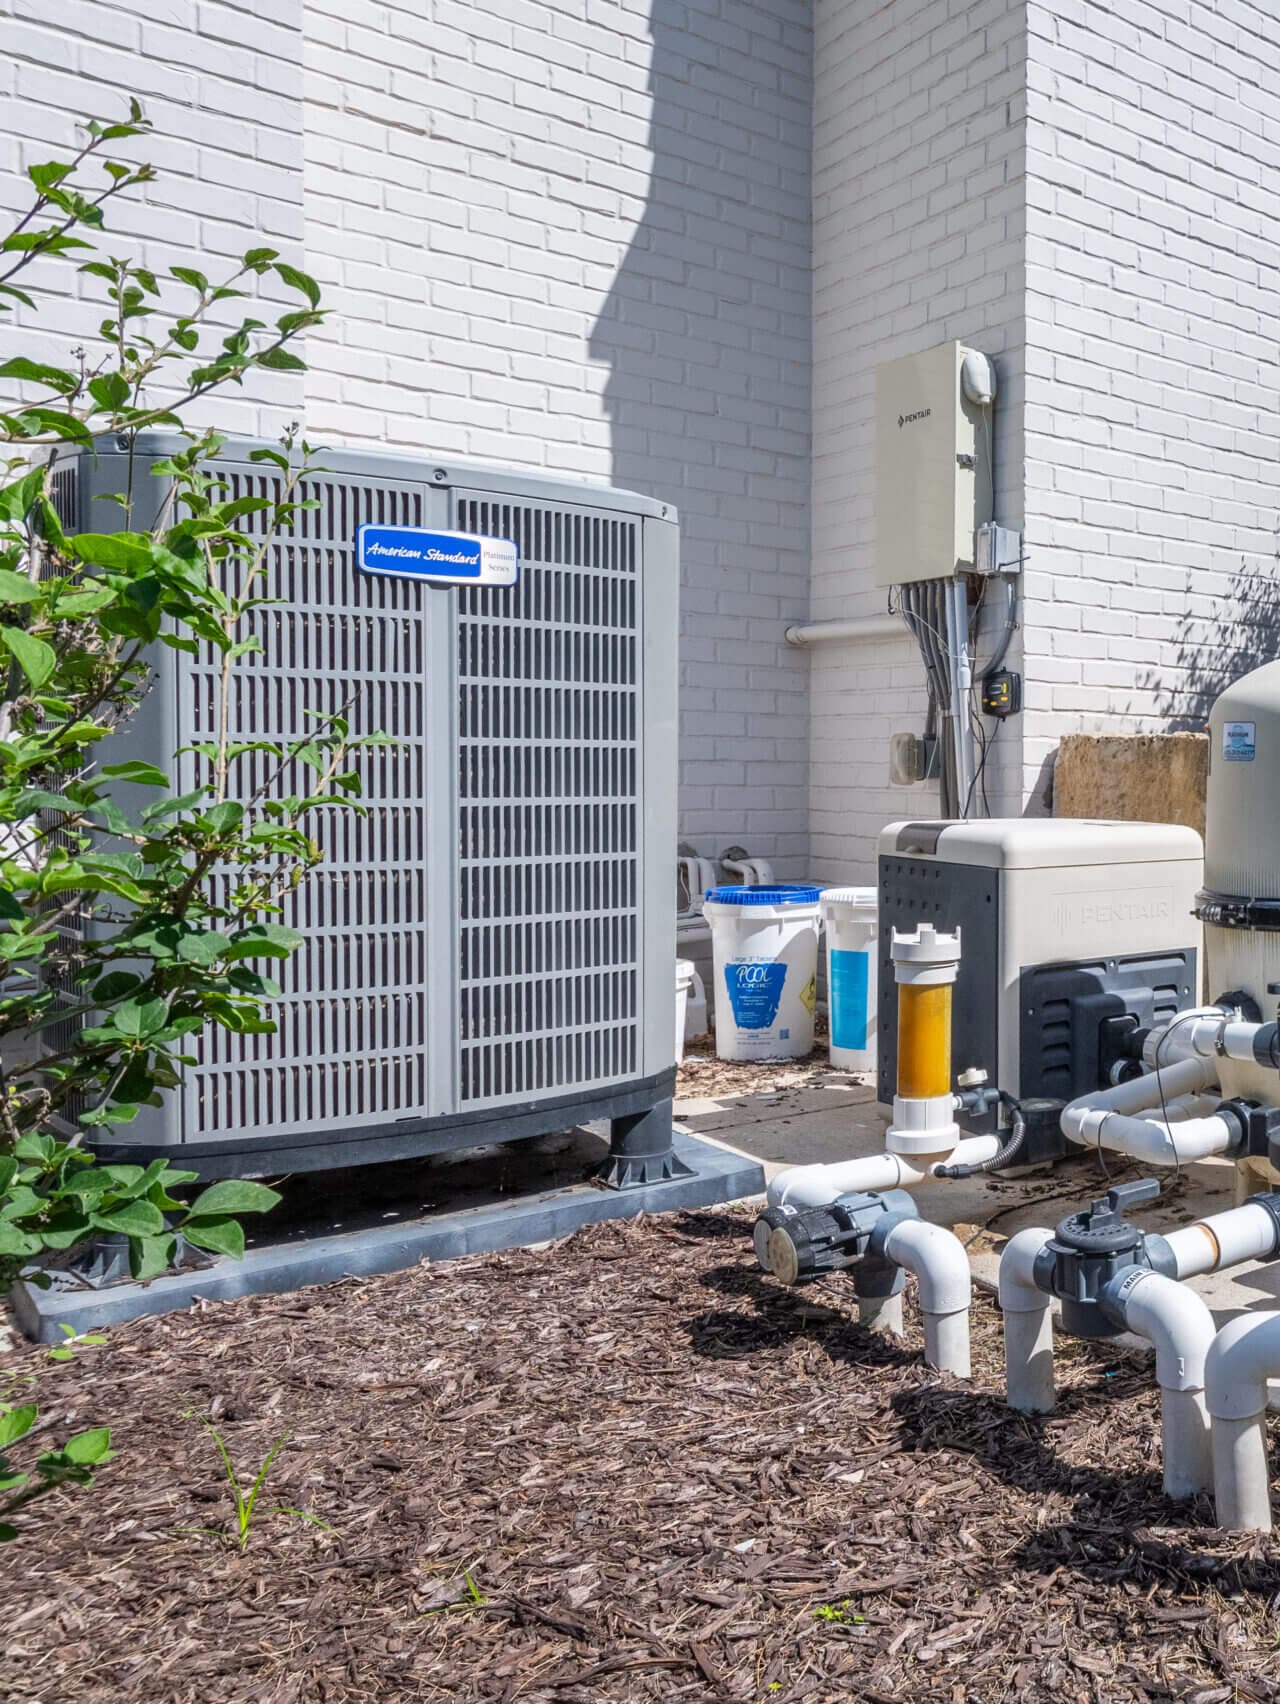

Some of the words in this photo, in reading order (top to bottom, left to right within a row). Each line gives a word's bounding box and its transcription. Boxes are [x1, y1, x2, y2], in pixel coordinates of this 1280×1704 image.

[905, 409, 931, 423] PENTAIR
[366, 542, 421, 559] American
[423, 549, 479, 565] Standard
[1081, 902, 1168, 923] PENTAIR
[1123, 1271, 1143, 1289] MAIN
